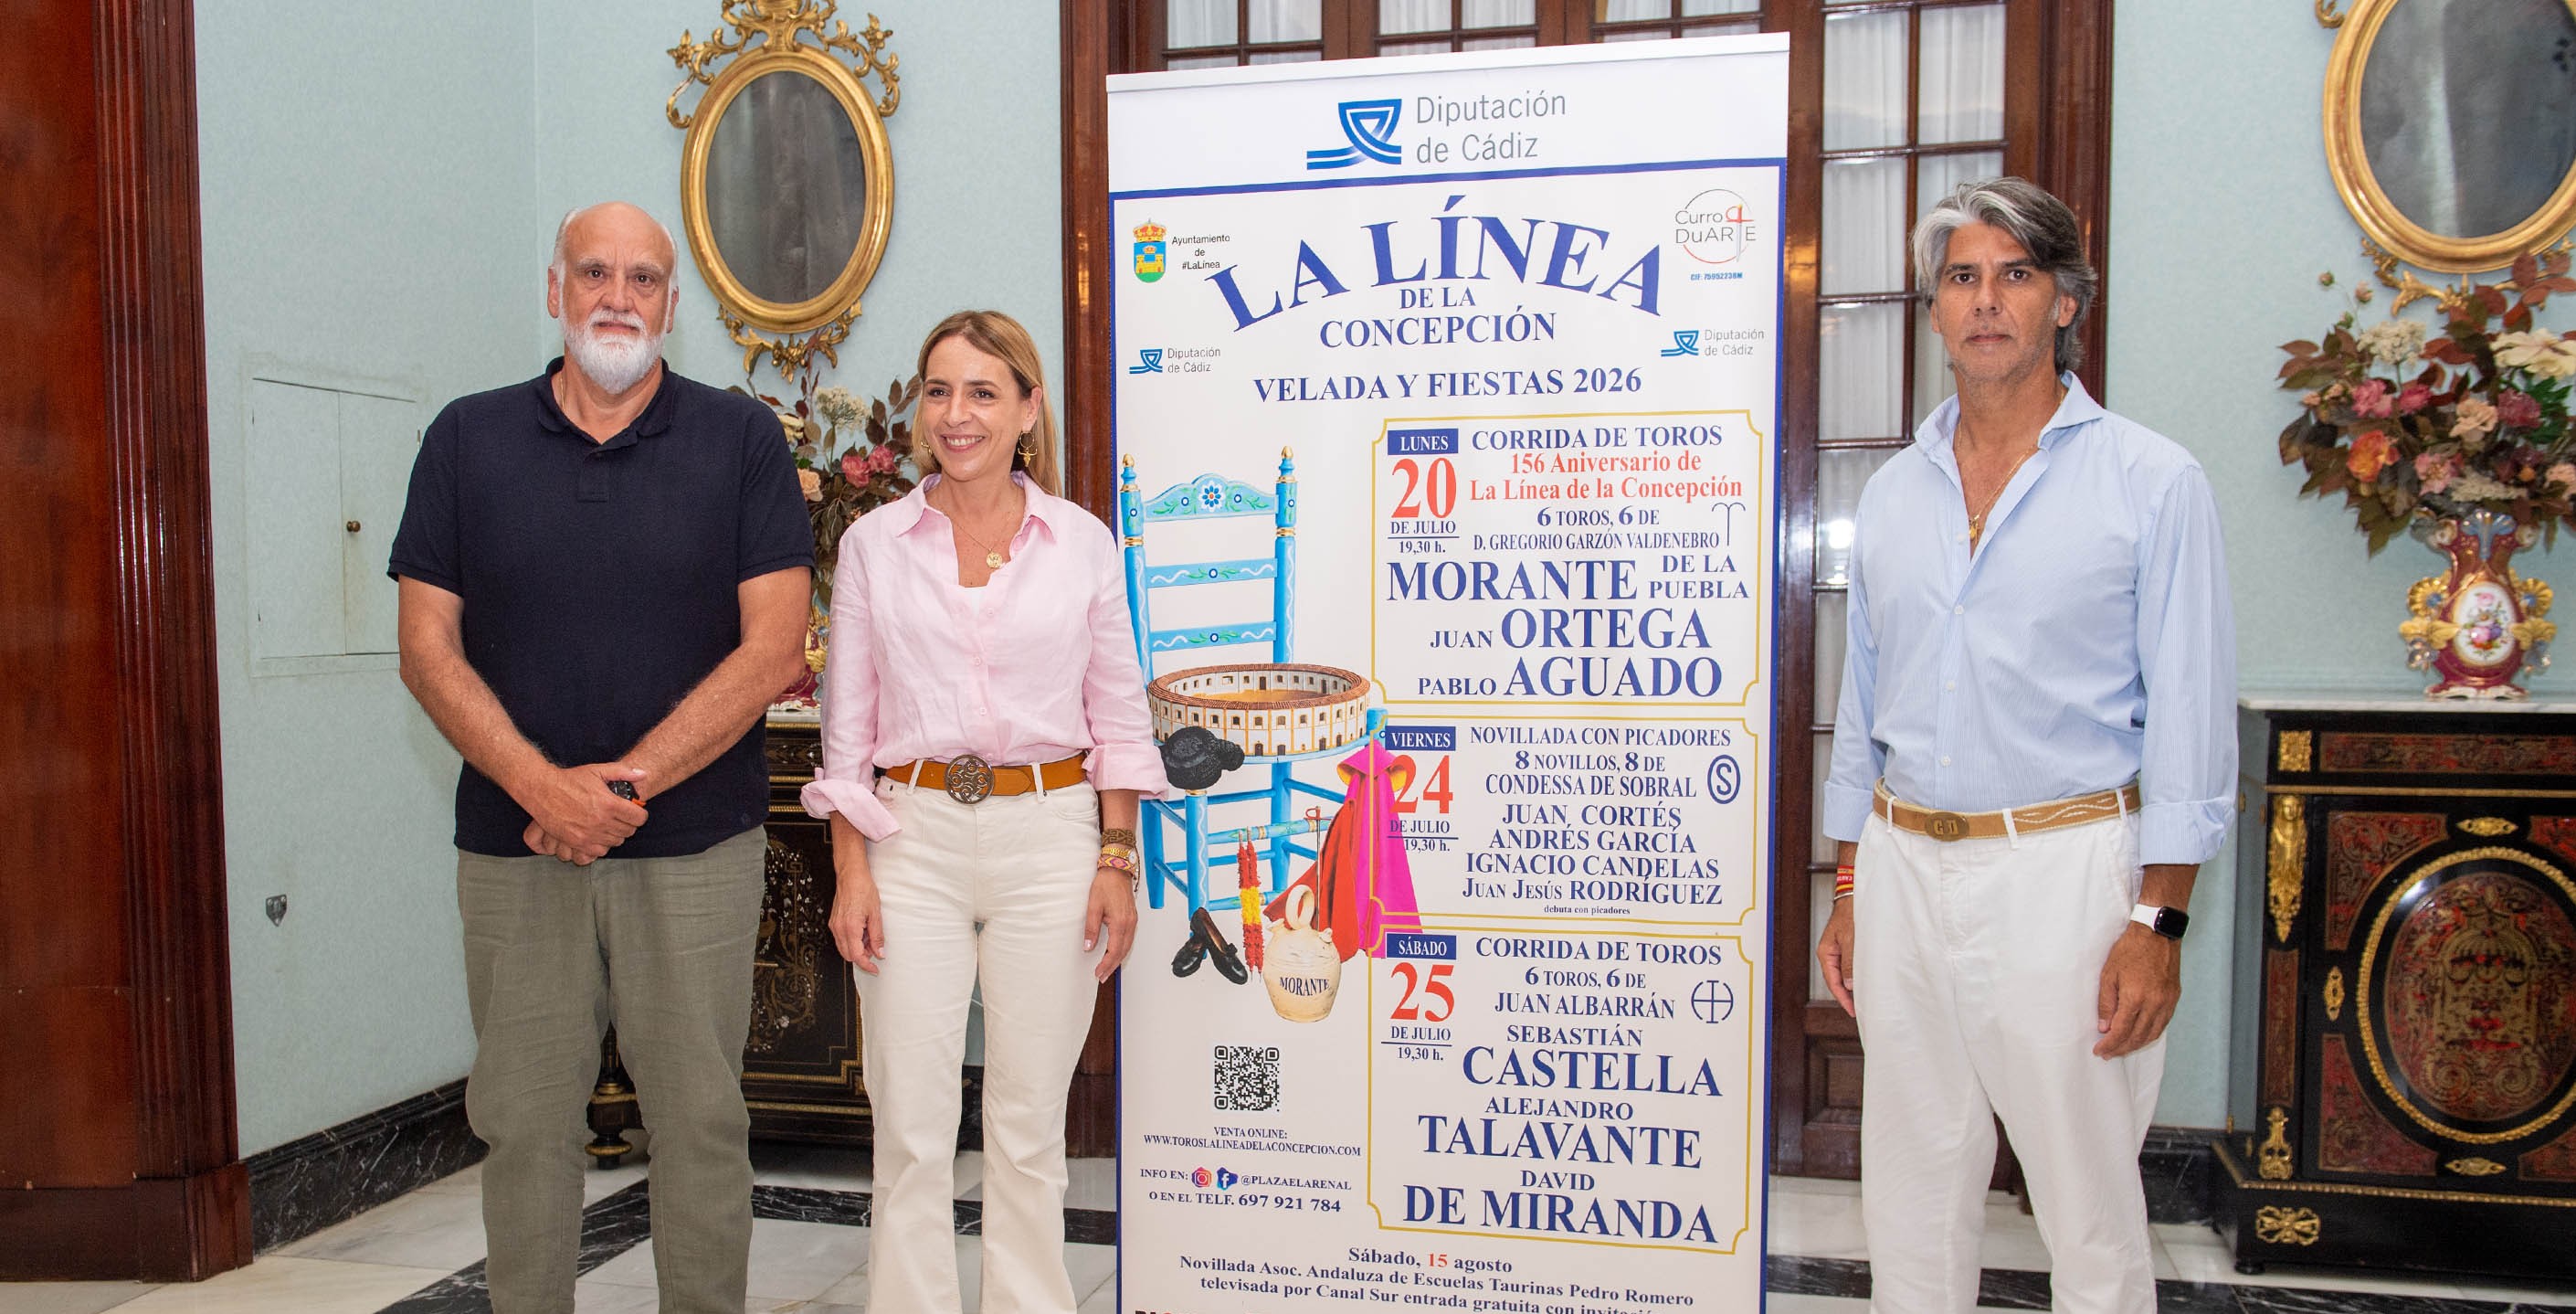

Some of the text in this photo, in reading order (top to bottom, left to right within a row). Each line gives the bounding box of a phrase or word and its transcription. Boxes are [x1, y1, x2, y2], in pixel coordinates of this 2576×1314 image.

[1416, 91, 1567, 126] Diputación
[1416, 132, 1539, 164] de Cádiz
[1675, 210, 1723, 224] Curro
[1172, 235, 1230, 246] Ayuntamiento
[1207, 196, 1662, 332] LA LÍNEA
[1400, 287, 1475, 310] DE LA
[1320, 305, 1557, 349] CONCEPCIÓN
[1704, 326, 1765, 344] Diputación
[1168, 347, 1220, 359] Diputación
[1705, 342, 1754, 356] de Cádiz
[1168, 362, 1210, 373] de Cádiz
[1253, 367, 1642, 403] VELADA Y FIESTAS 2026
[1400, 436, 1448, 450] LUNES
[1473, 426, 1722, 450] CORRIDA DE TOROS
[1512, 450, 1701, 473] 156 Aniversario de
[1391, 458, 1457, 518] 20
[1470, 476, 1742, 503] La Línea de la Concepción
[1390, 521, 1456, 535] DE JULIO
[1537, 506, 1660, 528] 6 TOROS, 6 DE
[1399, 540, 1445, 556] 19,30 h.
[1474, 529, 1719, 550] D. GREGORIO GARZÓN VALDENEBRO
[1663, 555, 1736, 573] DE LA
[1387, 560, 1636, 601] MORANTE
[1649, 581, 1749, 599] PUEBLA
[1431, 608, 1712, 649] JUAN ORTEGA
[1419, 656, 1722, 697] PABLO AGUADO
[1391, 733, 1451, 747] VIERNES
[1471, 726, 1731, 747] NOVILLADA CON PICADORES
[1515, 750, 1664, 773] 8 NOVILLOS, 8 DE
[1390, 755, 1453, 813] 24
[1486, 774, 1696, 798] CONDESSA DE SOBRAL
[1503, 801, 1681, 829] JUAN CORTÉS
[1390, 821, 1450, 833] DE JULIO
[1490, 824, 1696, 853] ANDRÉS GARCÍA
[1405, 839, 1450, 853] 19,30 h.
[1466, 853, 1718, 878] IGNACIO CANDELAS
[1570, 877, 1723, 905] RODRÍGUEZ
[1545, 905, 1572, 914] debuta
[1591, 906, 1630, 916] picadores
[1399, 937, 1447, 956] SÁBADO
[1476, 938, 1722, 965] CORRIDA DE TOROS
[1279, 977, 1330, 996] MORANTE
[1526, 967, 1646, 989] 6 TOROS, 6 DE
[1390, 962, 1455, 1022] 25
[1495, 990, 1675, 1020] JUAN ALBARRÁN
[1391, 1026, 1451, 1041] DE JULIO
[1507, 1023, 1642, 1046] SEBASTIÁN
[1398, 1047, 1444, 1062] 19,30 h.
[1462, 1046, 1723, 1097] CASTELLA
[1485, 1097, 1633, 1120] ALEJANDRO
[1214, 1127, 1287, 1139] VENTA ONLINE:
[1419, 1115, 1701, 1169] TALAVANTE
[1144, 1135, 1360, 1156] WWW.TOROSLALINEADELACONCEPCION.COM
[1140, 1169, 1167, 1178] INFO
[1170, 1171, 1188, 1180] EN:
[1241, 1175, 1351, 1190] @PLAZAELARENAL
[1520, 1170, 1595, 1191] DAVID
[1149, 1192, 1341, 1213] O EN EL TELF. 697 921 784
[1403, 1185, 1718, 1244] DE MIRANDA
[1348, 1247, 1512, 1273] Sábado, 15 agosto
[1180, 1256, 1694, 1306] Novillada Asoc. Andaluza de Escuelas Taurinas Pedro Romero
[1200, 1277, 1278, 1294] televisada
[1283, 1285, 1311, 1298] por
[1316, 1284, 1364, 1300] Canal
[1369, 1288, 1399, 1303] Sur
[1403, 1292, 1467, 1309] entrada
[1473, 1298, 1539, 1314] gratuita
[1546, 1305, 1575, 1314] con
